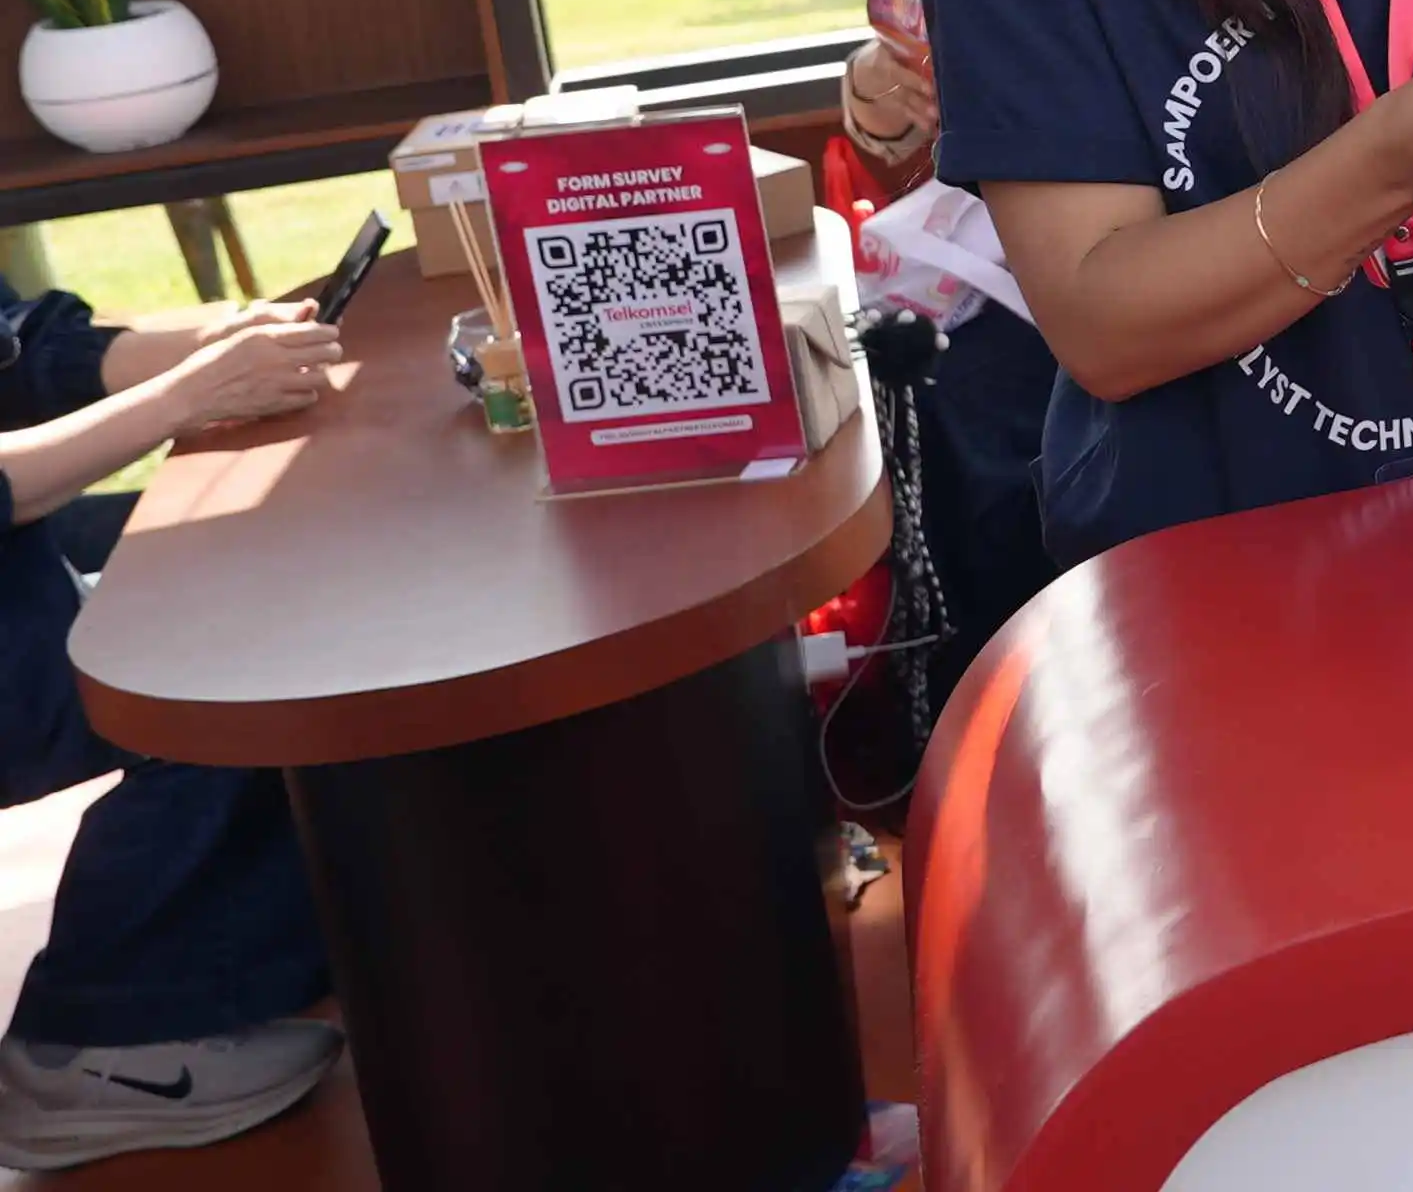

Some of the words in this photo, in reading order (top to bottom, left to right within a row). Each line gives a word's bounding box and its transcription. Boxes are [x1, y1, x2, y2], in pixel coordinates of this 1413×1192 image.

[557, 173, 612, 193] FORM
[612, 165, 683, 188] SURVEY
[546, 190, 620, 215] DIGITAL
[620, 184, 703, 208] PARTNER
[602, 299, 694, 325] Telkomsel
